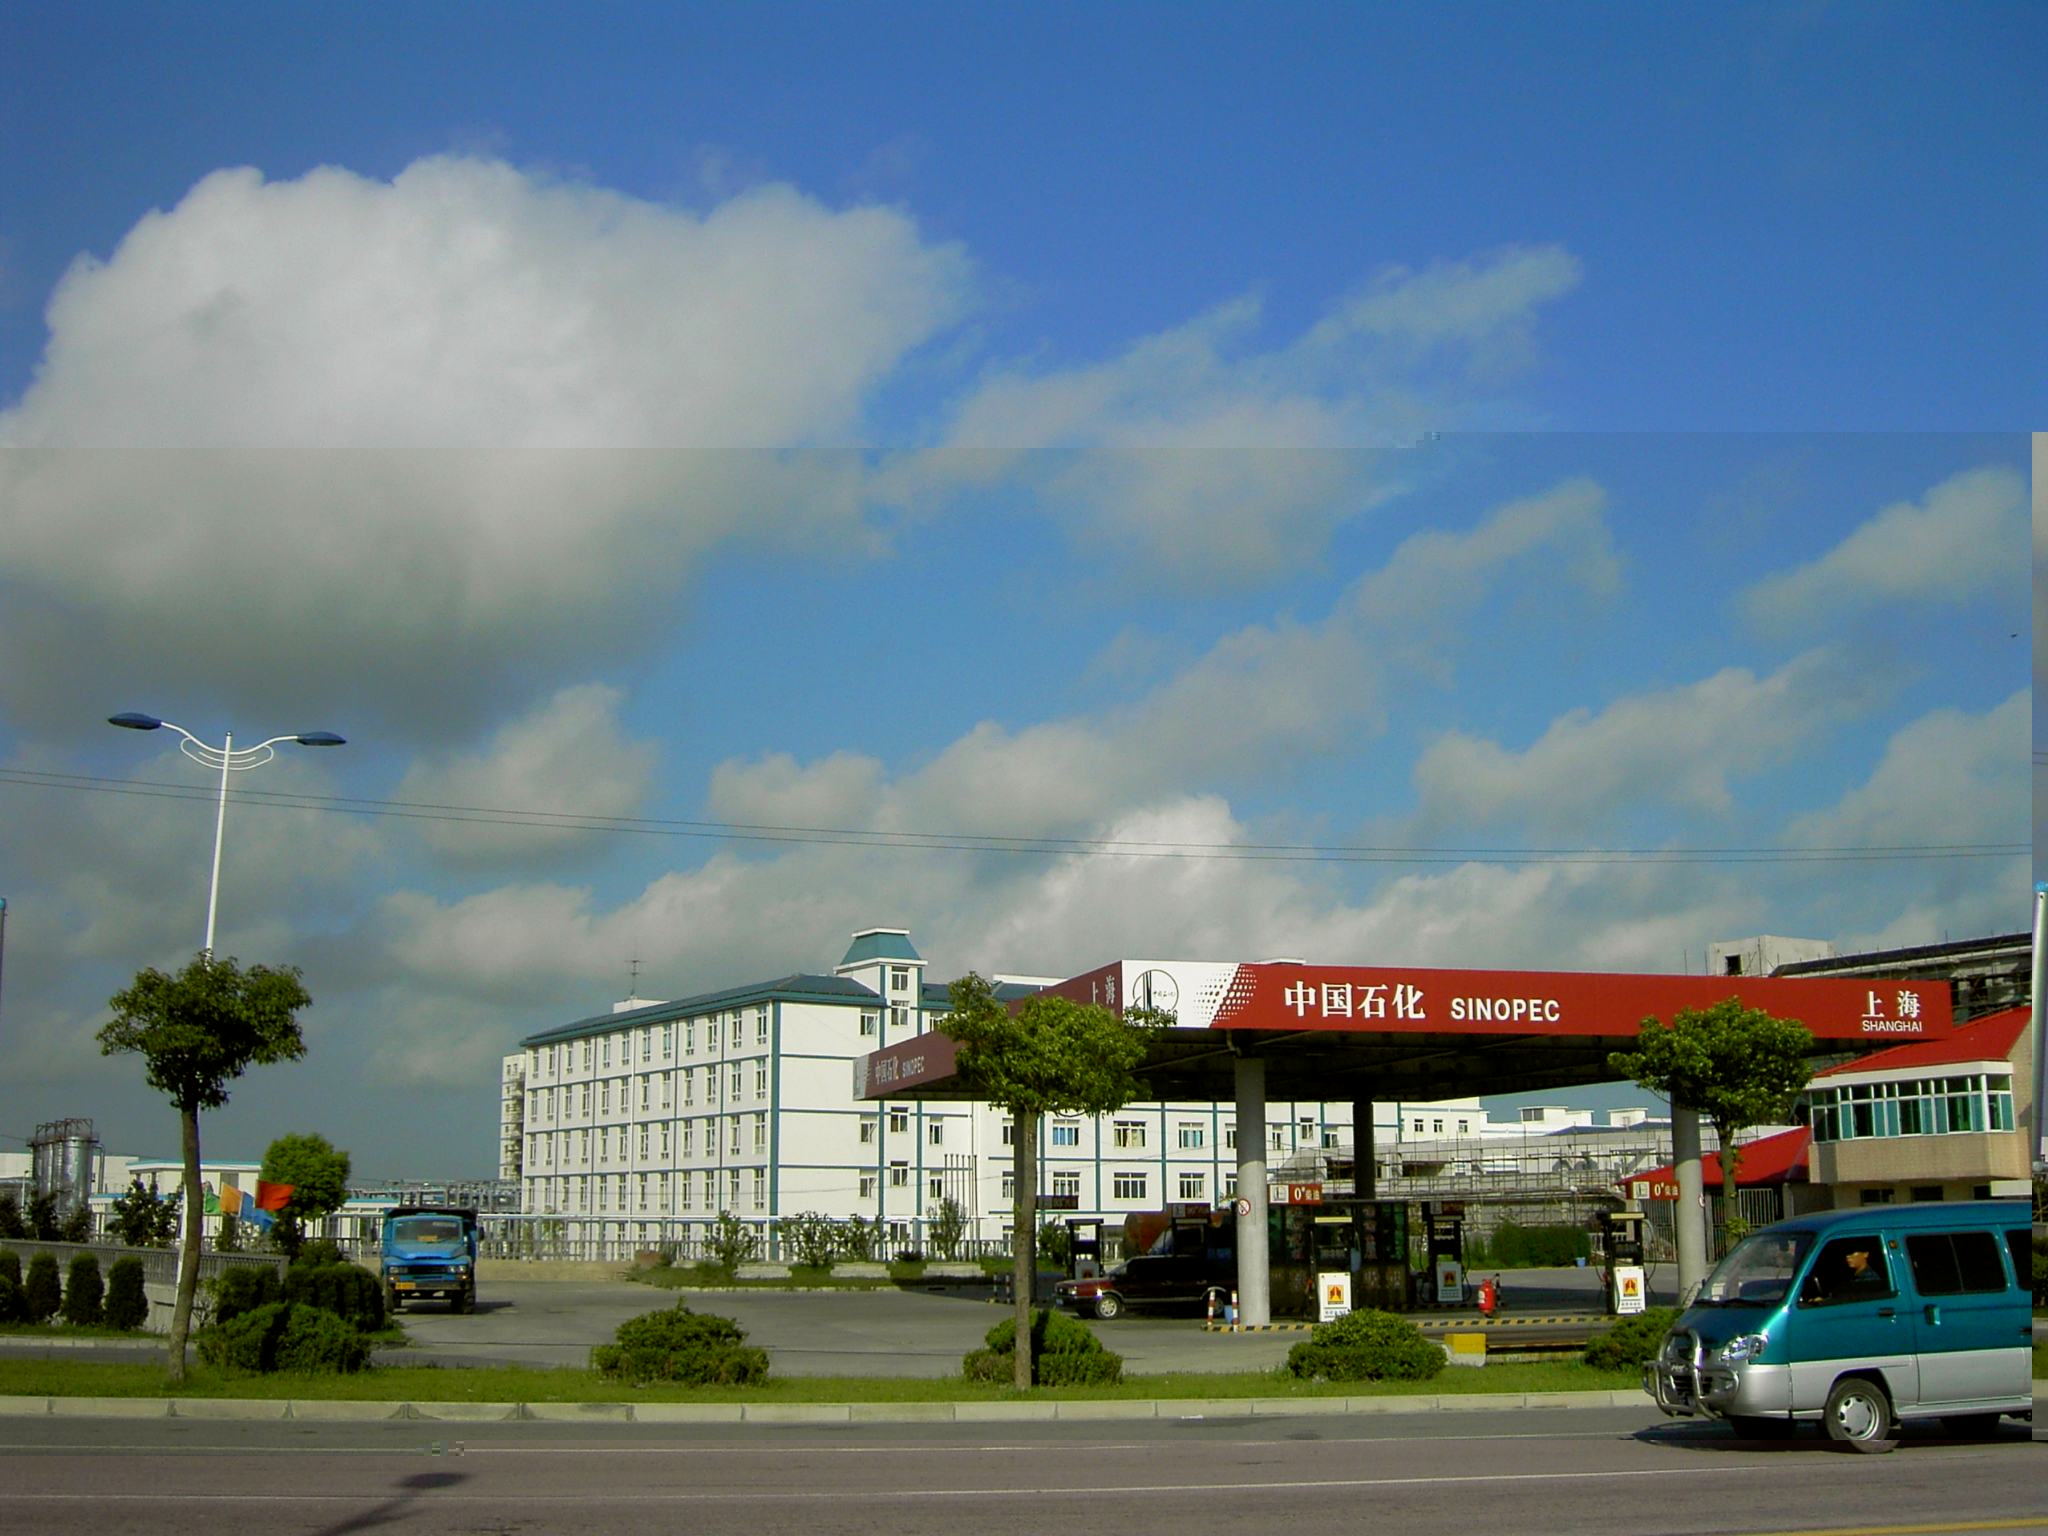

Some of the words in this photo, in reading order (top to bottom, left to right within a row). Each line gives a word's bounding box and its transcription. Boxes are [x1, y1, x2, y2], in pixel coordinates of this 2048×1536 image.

[1284, 981, 1426, 1018] 中国石化
[1450, 997, 1560, 1022] SINOPEC
[1861, 990, 1920, 1018] 上海
[1862, 1020, 1923, 1032] SHANGHAI
